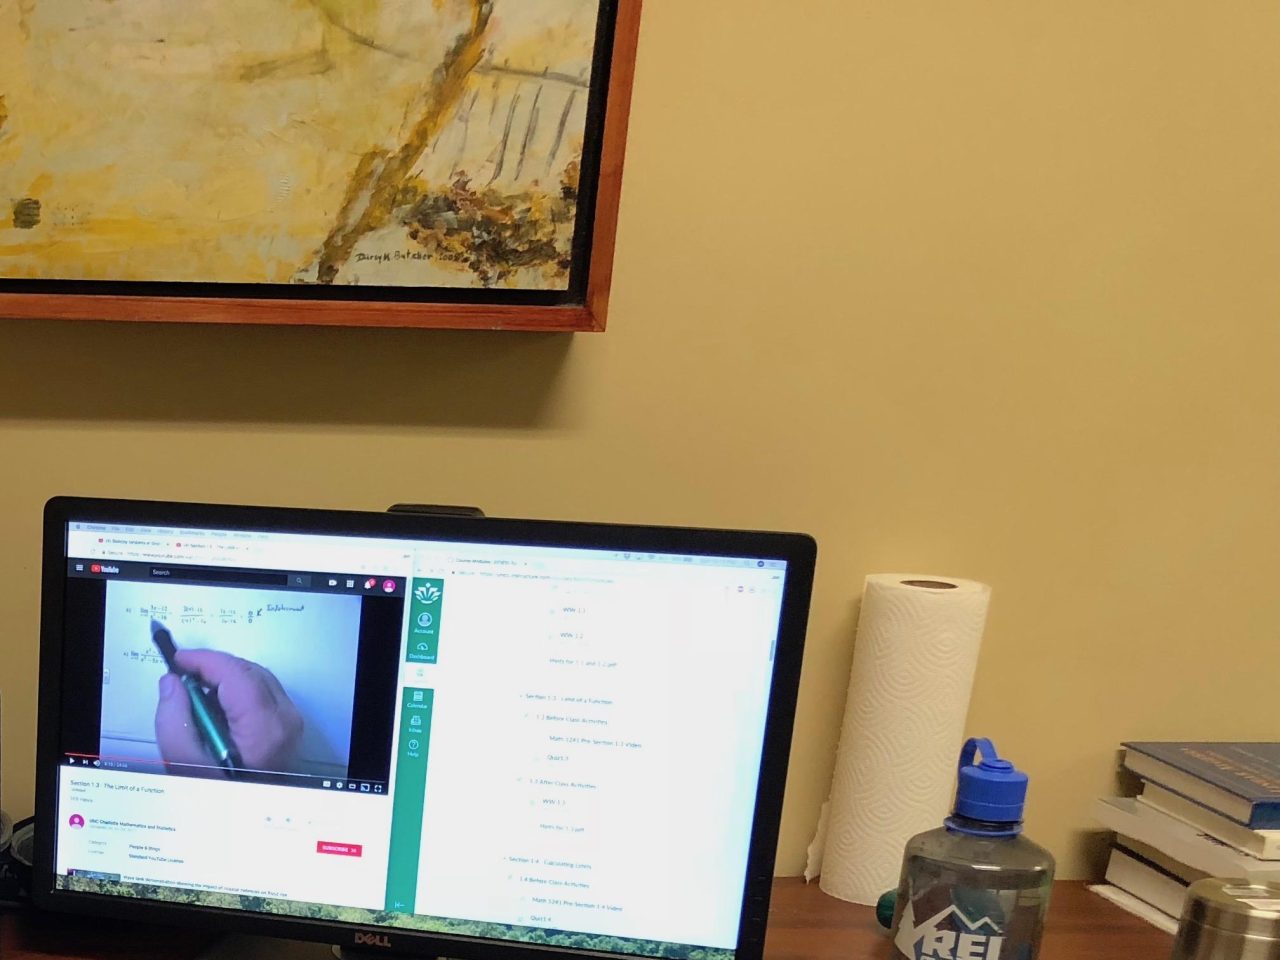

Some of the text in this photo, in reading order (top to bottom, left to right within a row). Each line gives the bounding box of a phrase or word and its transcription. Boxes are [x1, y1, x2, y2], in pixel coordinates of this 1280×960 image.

[101, 565, 119, 574] YouTube
[152, 568, 170, 576] Search
[414, 627, 434, 635] Account
[409, 653, 435, 661] Dashboard
[70, 779, 90, 788] Section
[141, 786, 165, 794] Function
[355, 932, 392, 948] DELL
